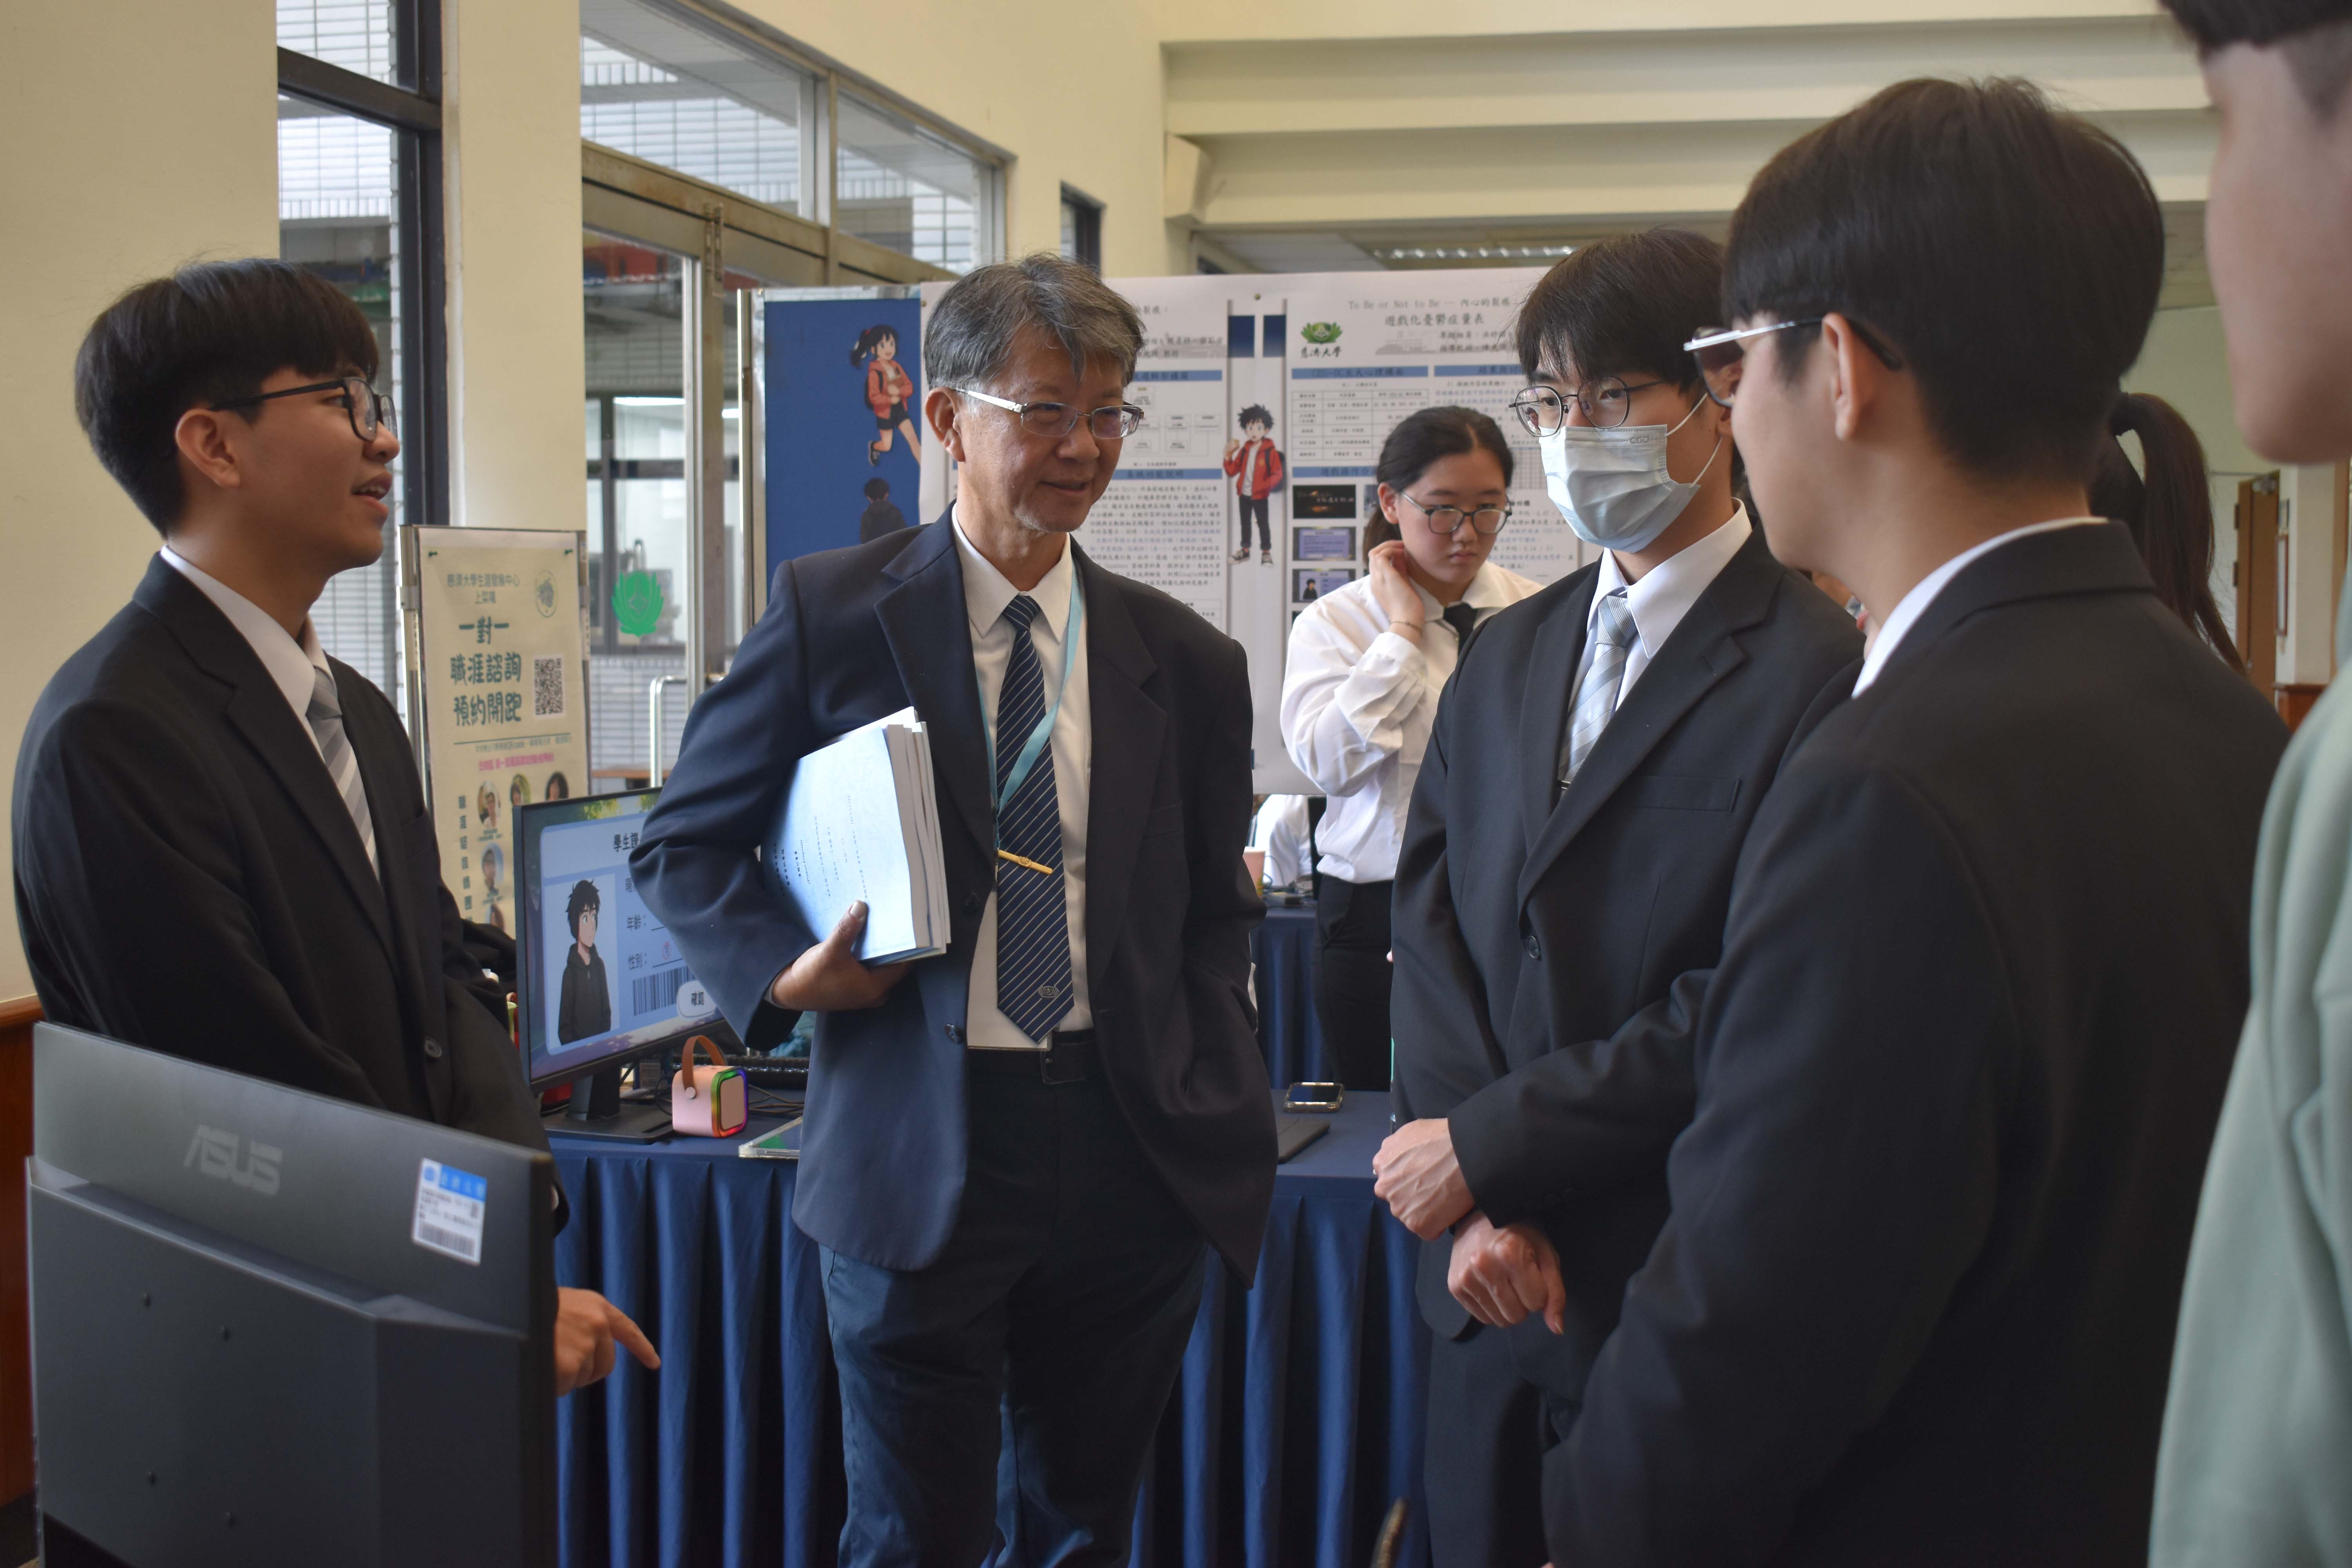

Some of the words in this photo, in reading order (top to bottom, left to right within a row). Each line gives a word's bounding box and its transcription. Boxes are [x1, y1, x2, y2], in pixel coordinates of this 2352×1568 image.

[458, 615, 510, 645] 一對一
[450, 652, 521, 687] 職涯諮詢
[454, 692, 521, 726] 預約開跑
[183, 1123, 284, 1196] ASUS
